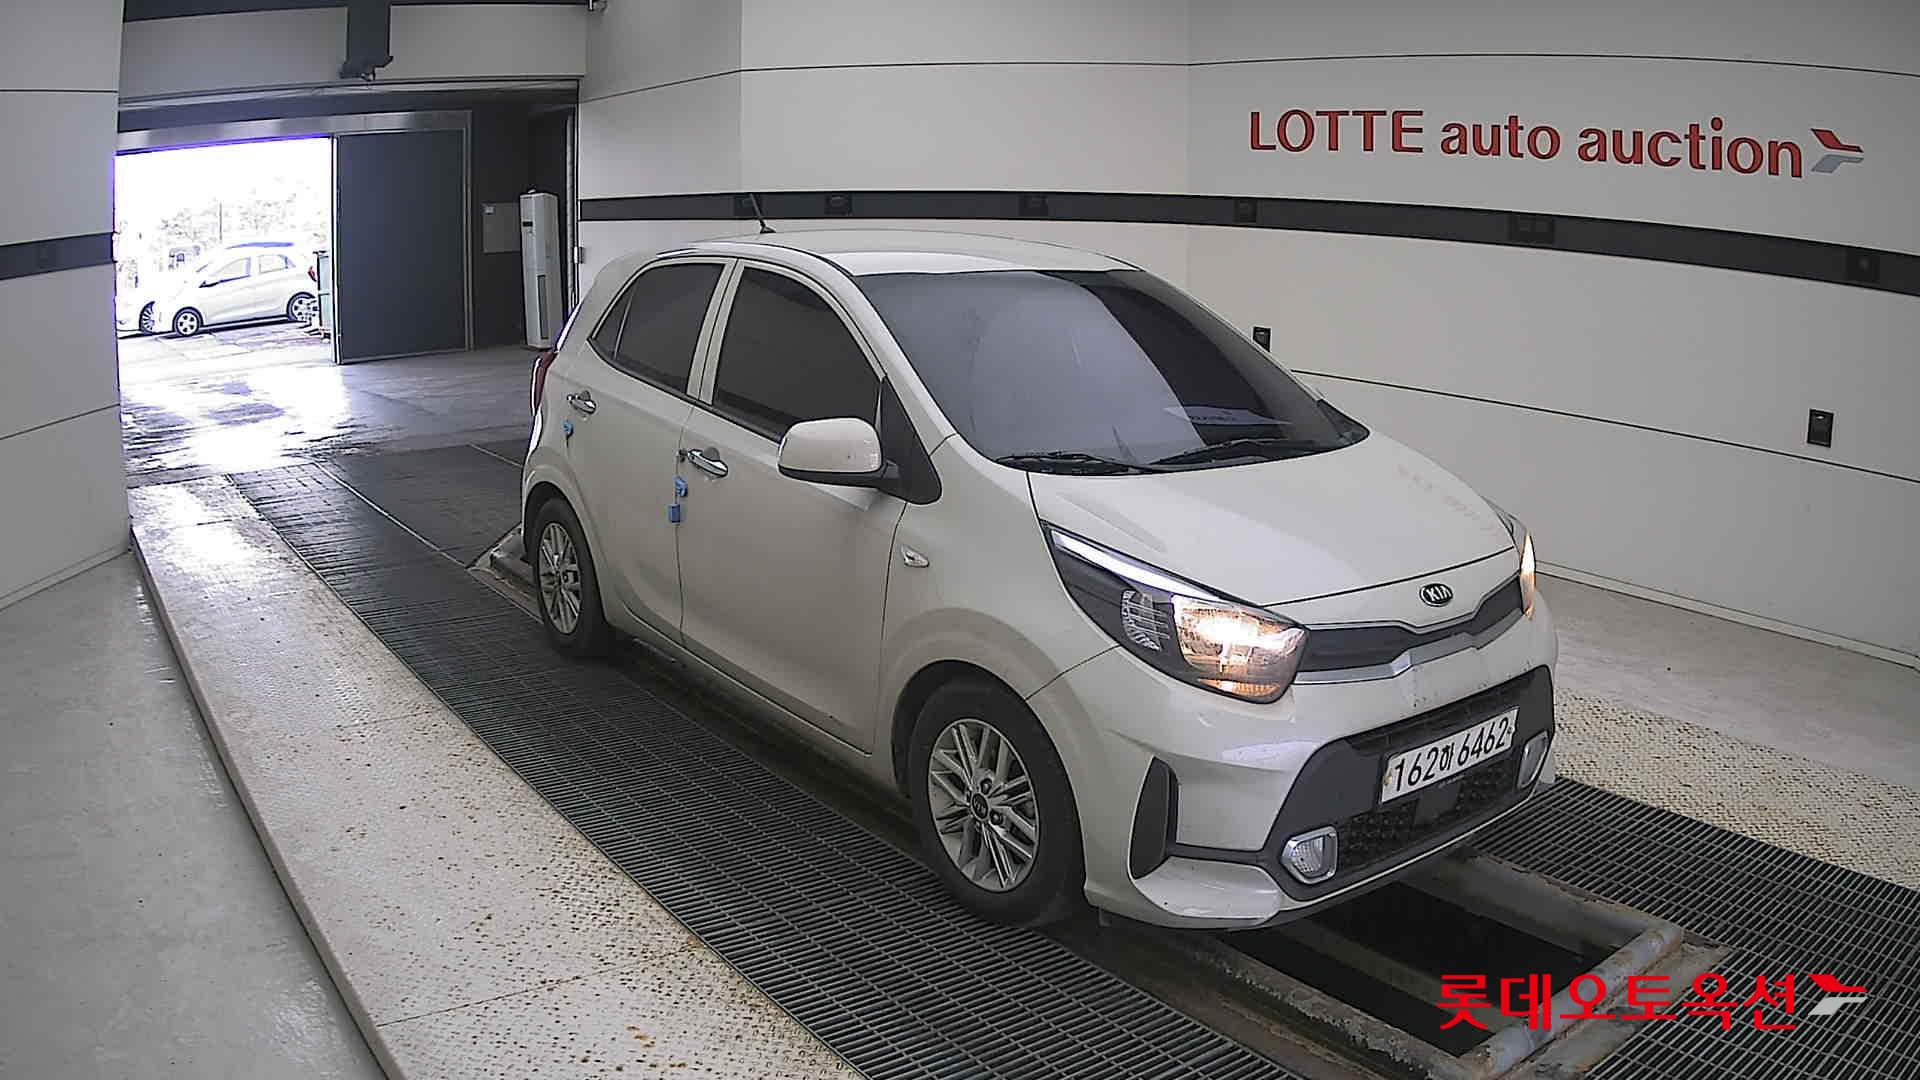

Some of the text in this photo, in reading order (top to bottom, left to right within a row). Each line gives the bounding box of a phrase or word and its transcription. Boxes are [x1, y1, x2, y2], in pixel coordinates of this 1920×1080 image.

[1249, 109, 1803, 179] LOTTE auto auction
[1424, 585, 1452, 602] KIA
